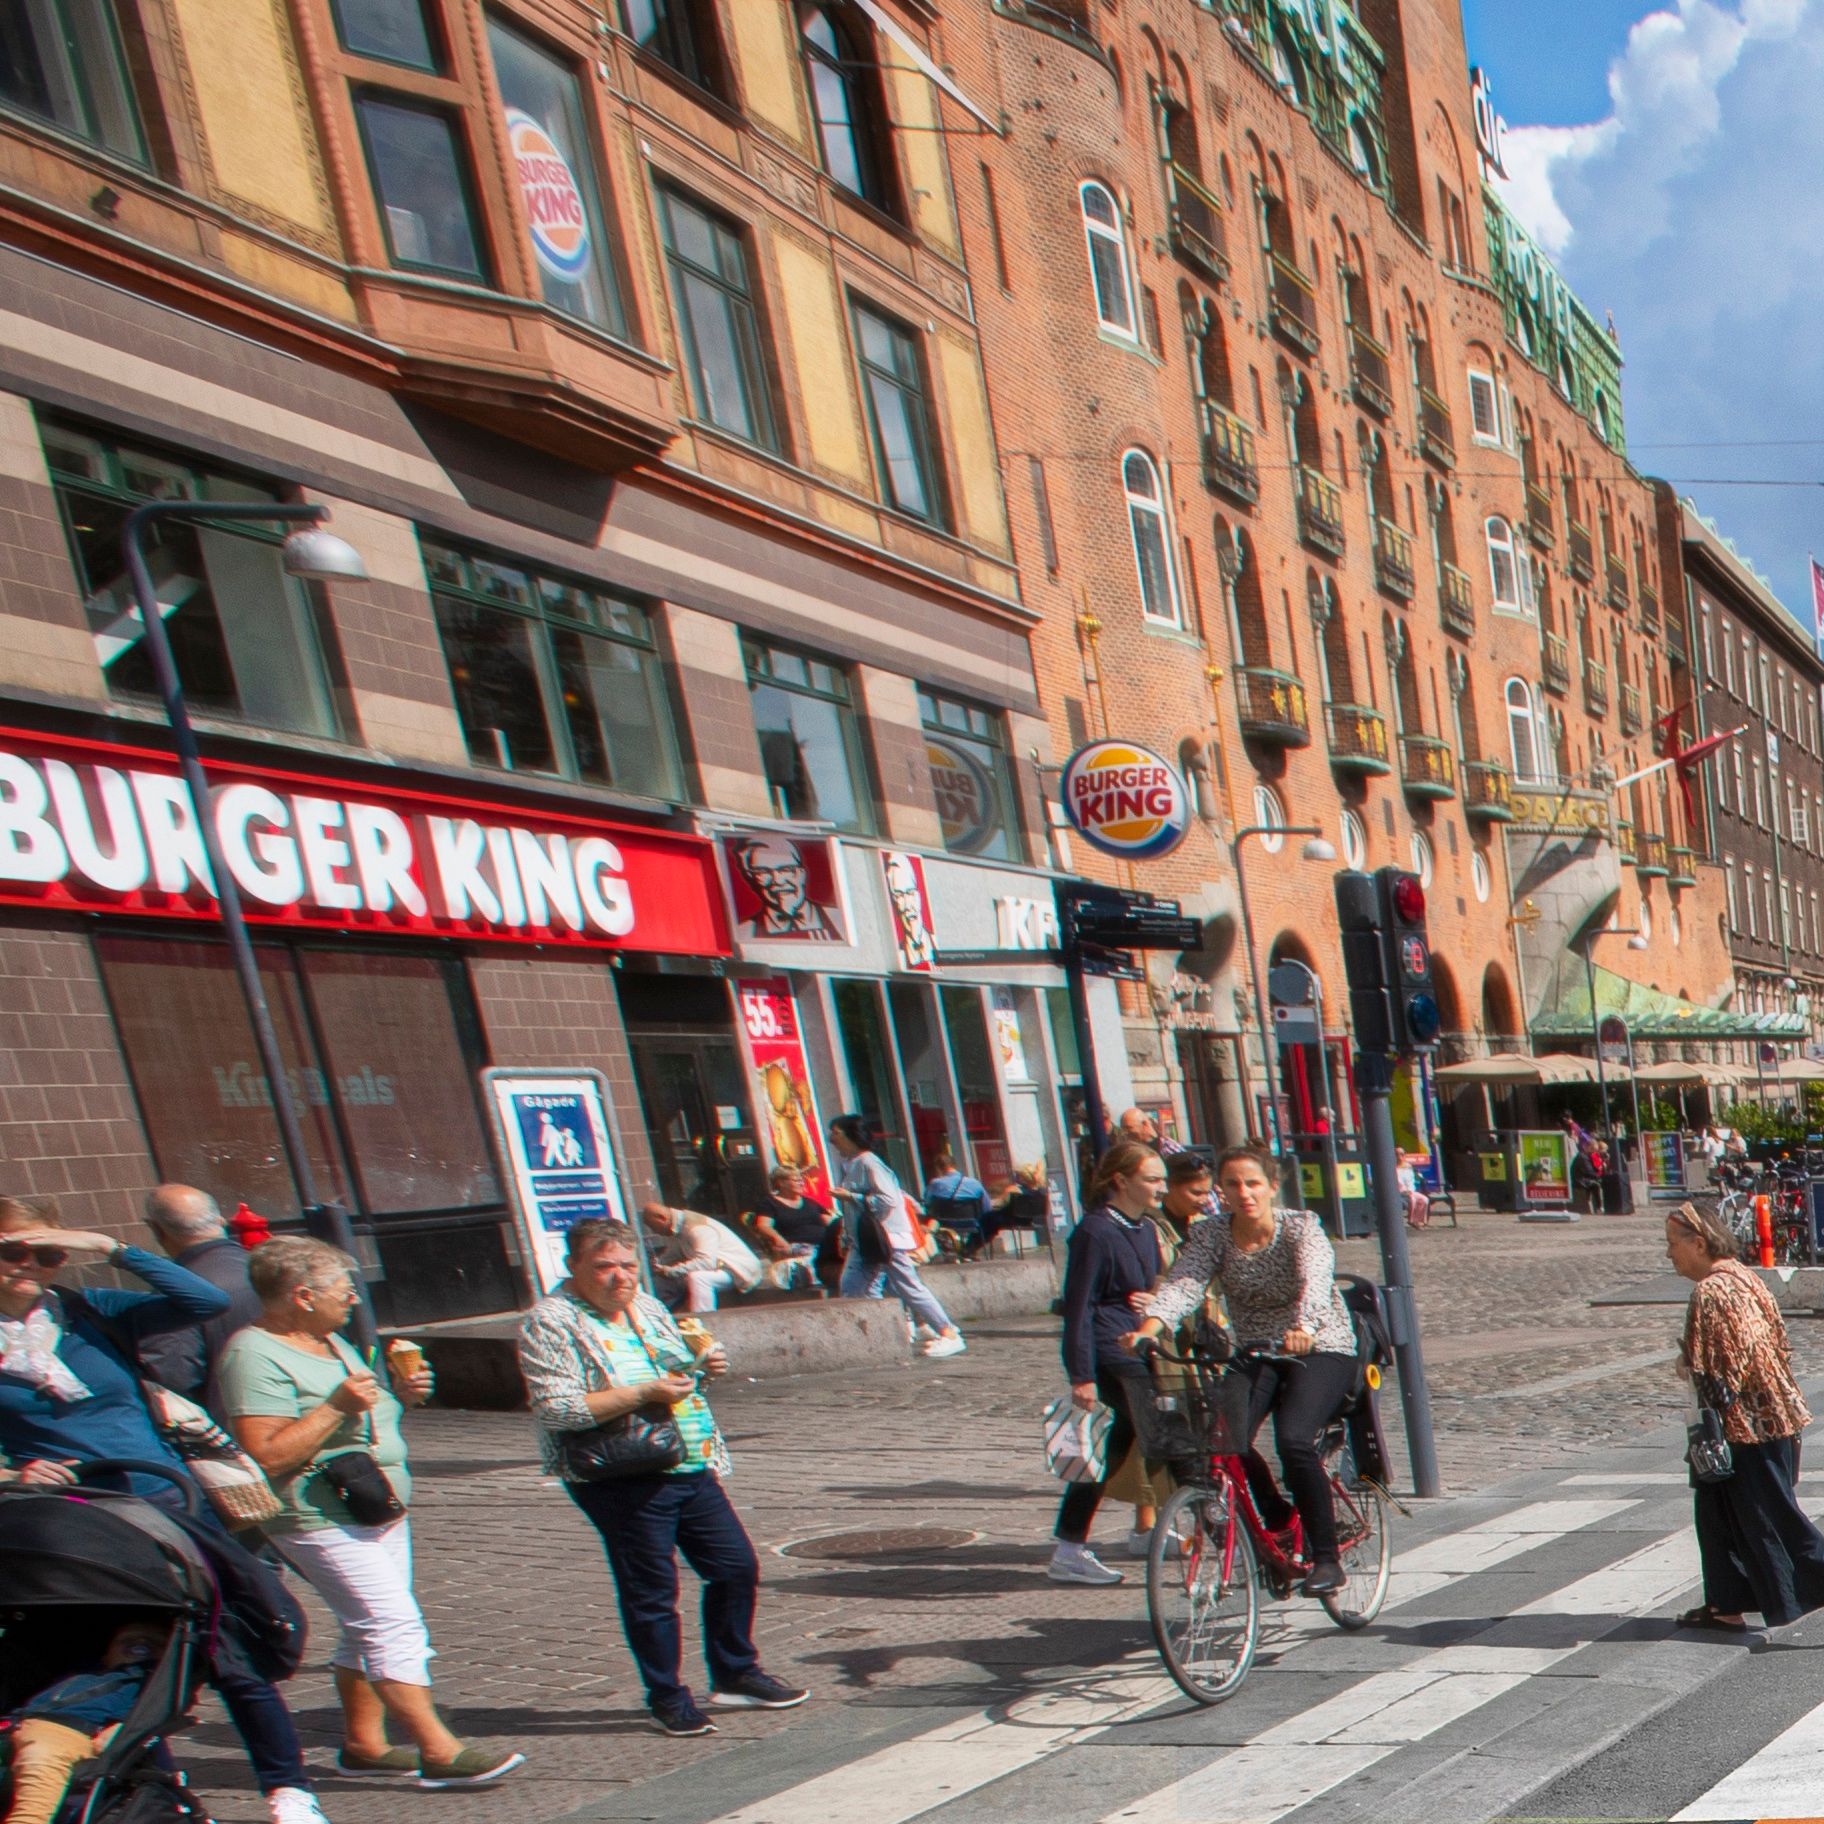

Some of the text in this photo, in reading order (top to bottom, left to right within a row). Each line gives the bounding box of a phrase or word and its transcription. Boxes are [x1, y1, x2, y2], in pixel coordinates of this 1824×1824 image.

[525, 187, 583, 226] KING
[1074, 767, 1168, 797] BURGER
[1079, 788, 1172, 827] KING
[0, 753, 635, 937] BURGER KING
[523, 1095, 577, 1109] Gågade
